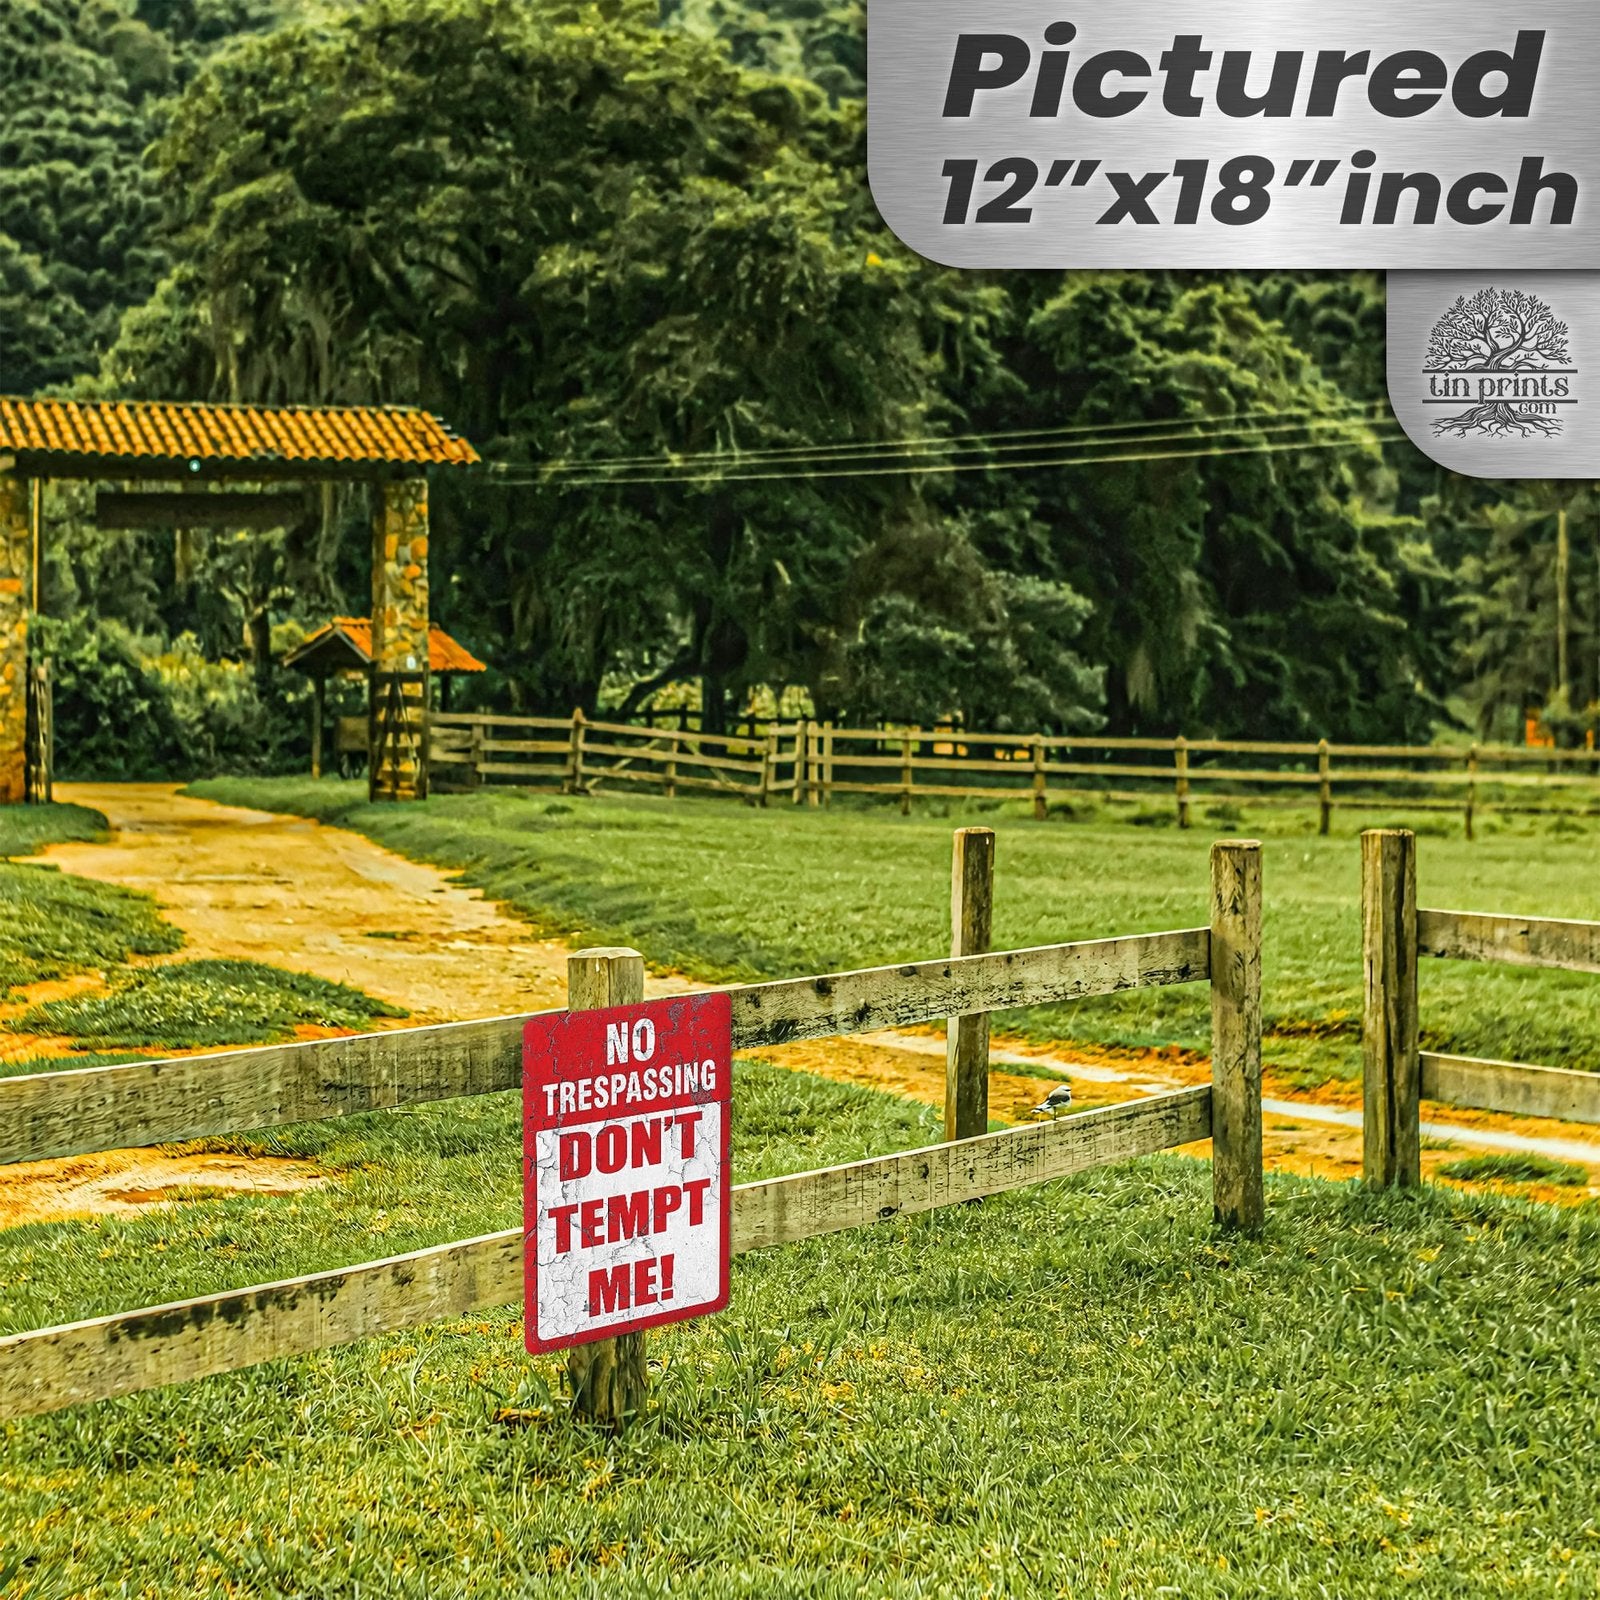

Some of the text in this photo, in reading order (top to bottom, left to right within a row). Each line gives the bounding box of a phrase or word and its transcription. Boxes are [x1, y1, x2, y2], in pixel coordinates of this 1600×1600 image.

[606, 1018, 655, 1066] NO
[542, 1059, 716, 1116] TRESPASSING
[548, 1178, 711, 1254] TEMPT
[588, 1253, 675, 1317] ME!
